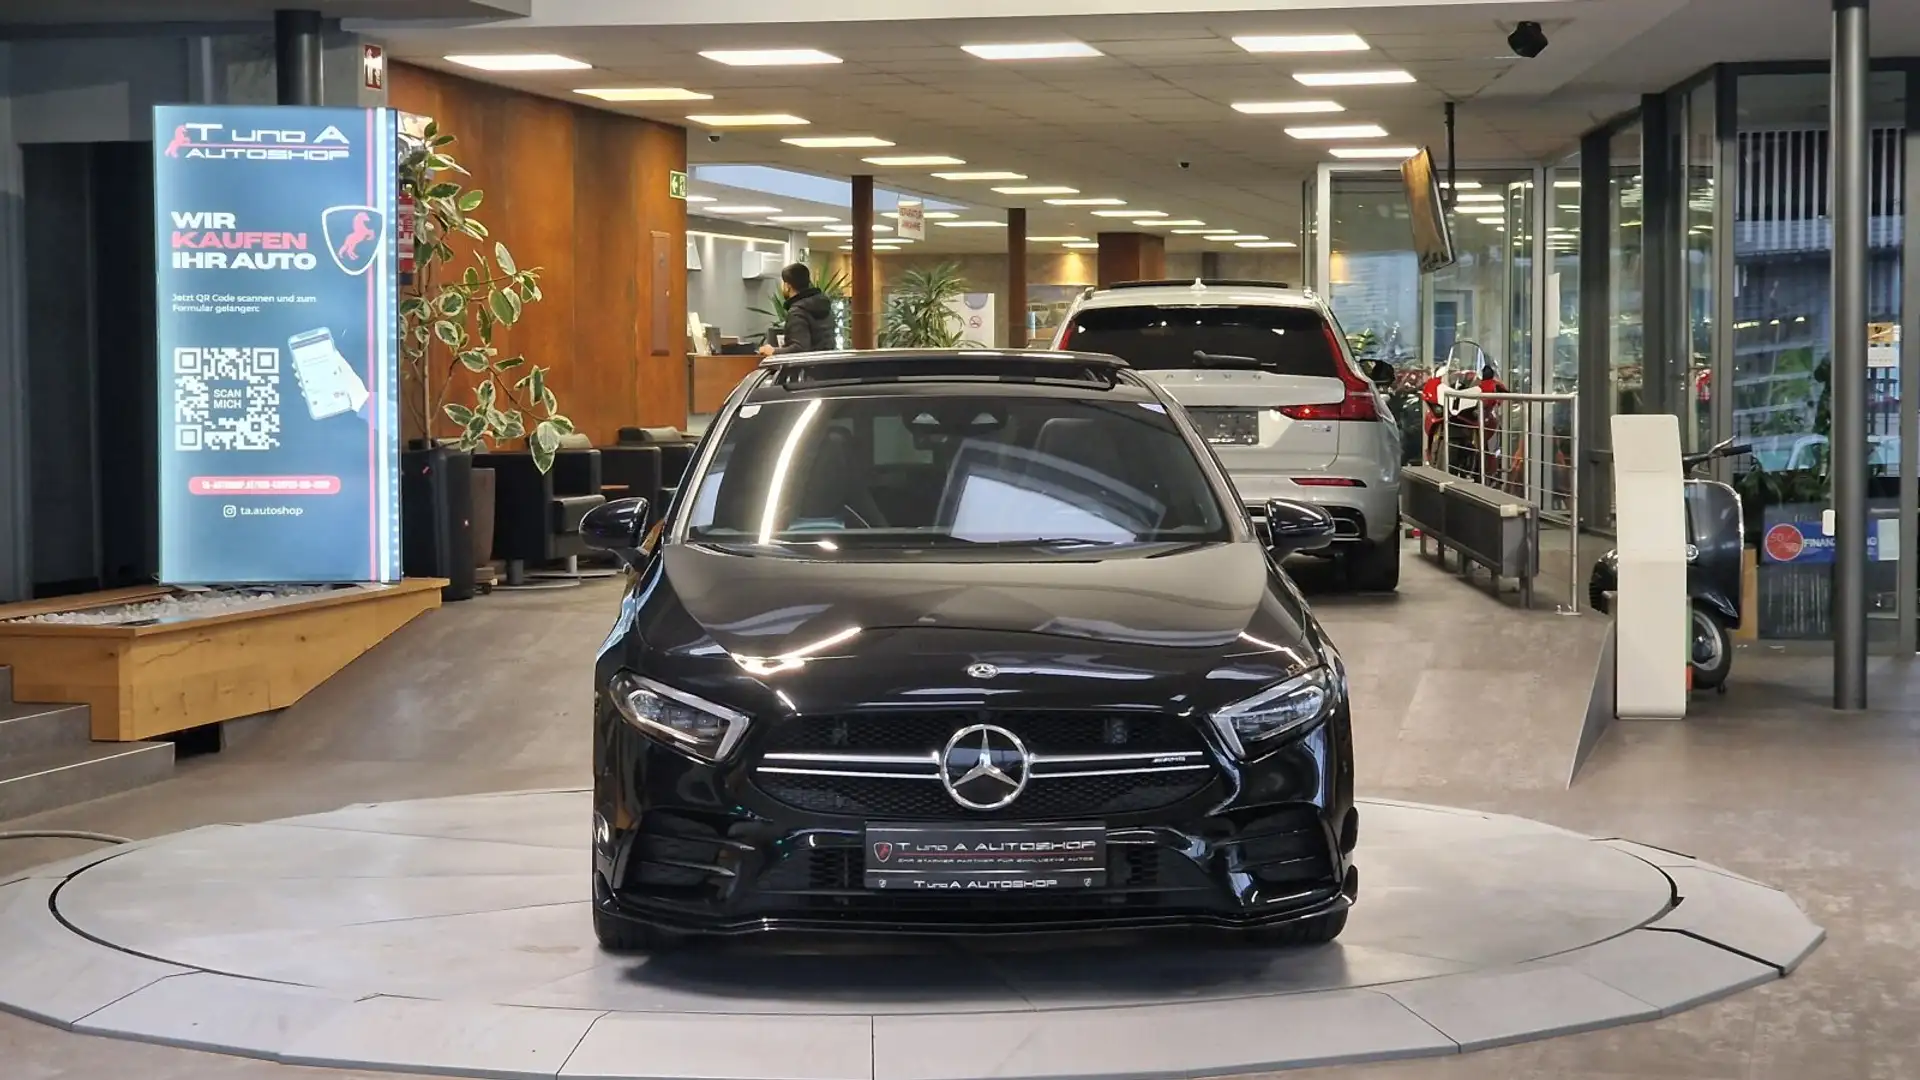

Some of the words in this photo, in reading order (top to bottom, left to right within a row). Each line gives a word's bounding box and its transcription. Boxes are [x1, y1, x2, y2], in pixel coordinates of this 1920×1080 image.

[185, 123, 223, 141] T
[313, 125, 350, 144] A
[185, 148, 350, 161] AUTOSHOP
[171, 211, 236, 229] WIR
[171, 231, 307, 250] KAUFEN
[172, 252, 232, 269] IHR
[230, 252, 317, 270] AUTO
[172, 293, 195, 302] Jetzt
[196, 293, 210, 303] QR
[212, 293, 235, 303] Code
[237, 294, 274, 303] scannen
[277, 293, 295, 303] und
[296, 295, 317, 303] zum
[172, 304, 213, 313] Formular
[213, 389, 242, 398] SCAN
[213, 400, 242, 409] MICH
[240, 506, 304, 517] ta.autoshop
[895, 842, 911, 851] T
[953, 843, 968, 851] A
[974, 841, 1097, 851] AUTOSHOP
[913, 880, 925, 888] T
[950, 880, 961, 888] A
[967, 879, 1058, 889] AUTOSHOP
